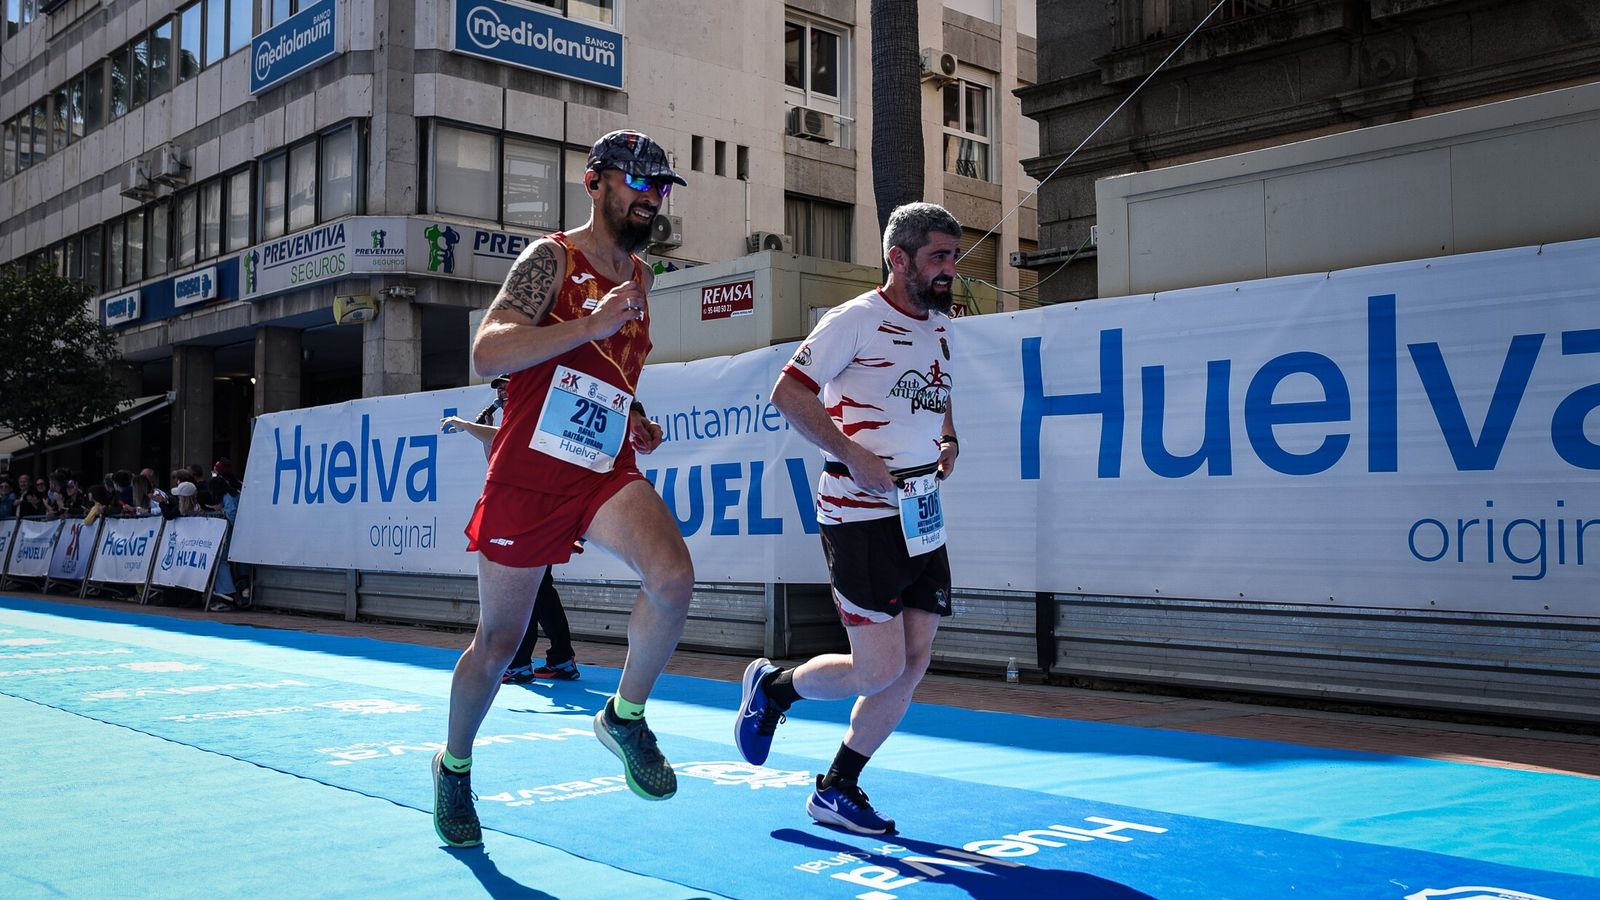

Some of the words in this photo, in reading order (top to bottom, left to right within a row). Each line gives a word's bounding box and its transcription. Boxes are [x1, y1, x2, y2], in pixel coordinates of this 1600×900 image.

[313, 8, 331, 25] BANCO
[257, 17, 332, 70] mediolanum
[473, 14, 615, 68] mediolanum
[585, 36, 615, 51] BANCO
[263, 223, 346, 266] PREVENTIVA
[290, 252, 346, 284] SEGUROS
[703, 283, 752, 304] REMSA
[570, 398, 609, 434] 275
[578, 426, 596, 438] RAFAEL
[650, 394, 791, 442] untamie
[272, 413, 438, 505] Huelva
[560, 440, 597, 461] Huelva
[646, 457, 821, 538] UELV
[369, 516, 437, 556] original
[477, 775, 627, 801] UELVA
